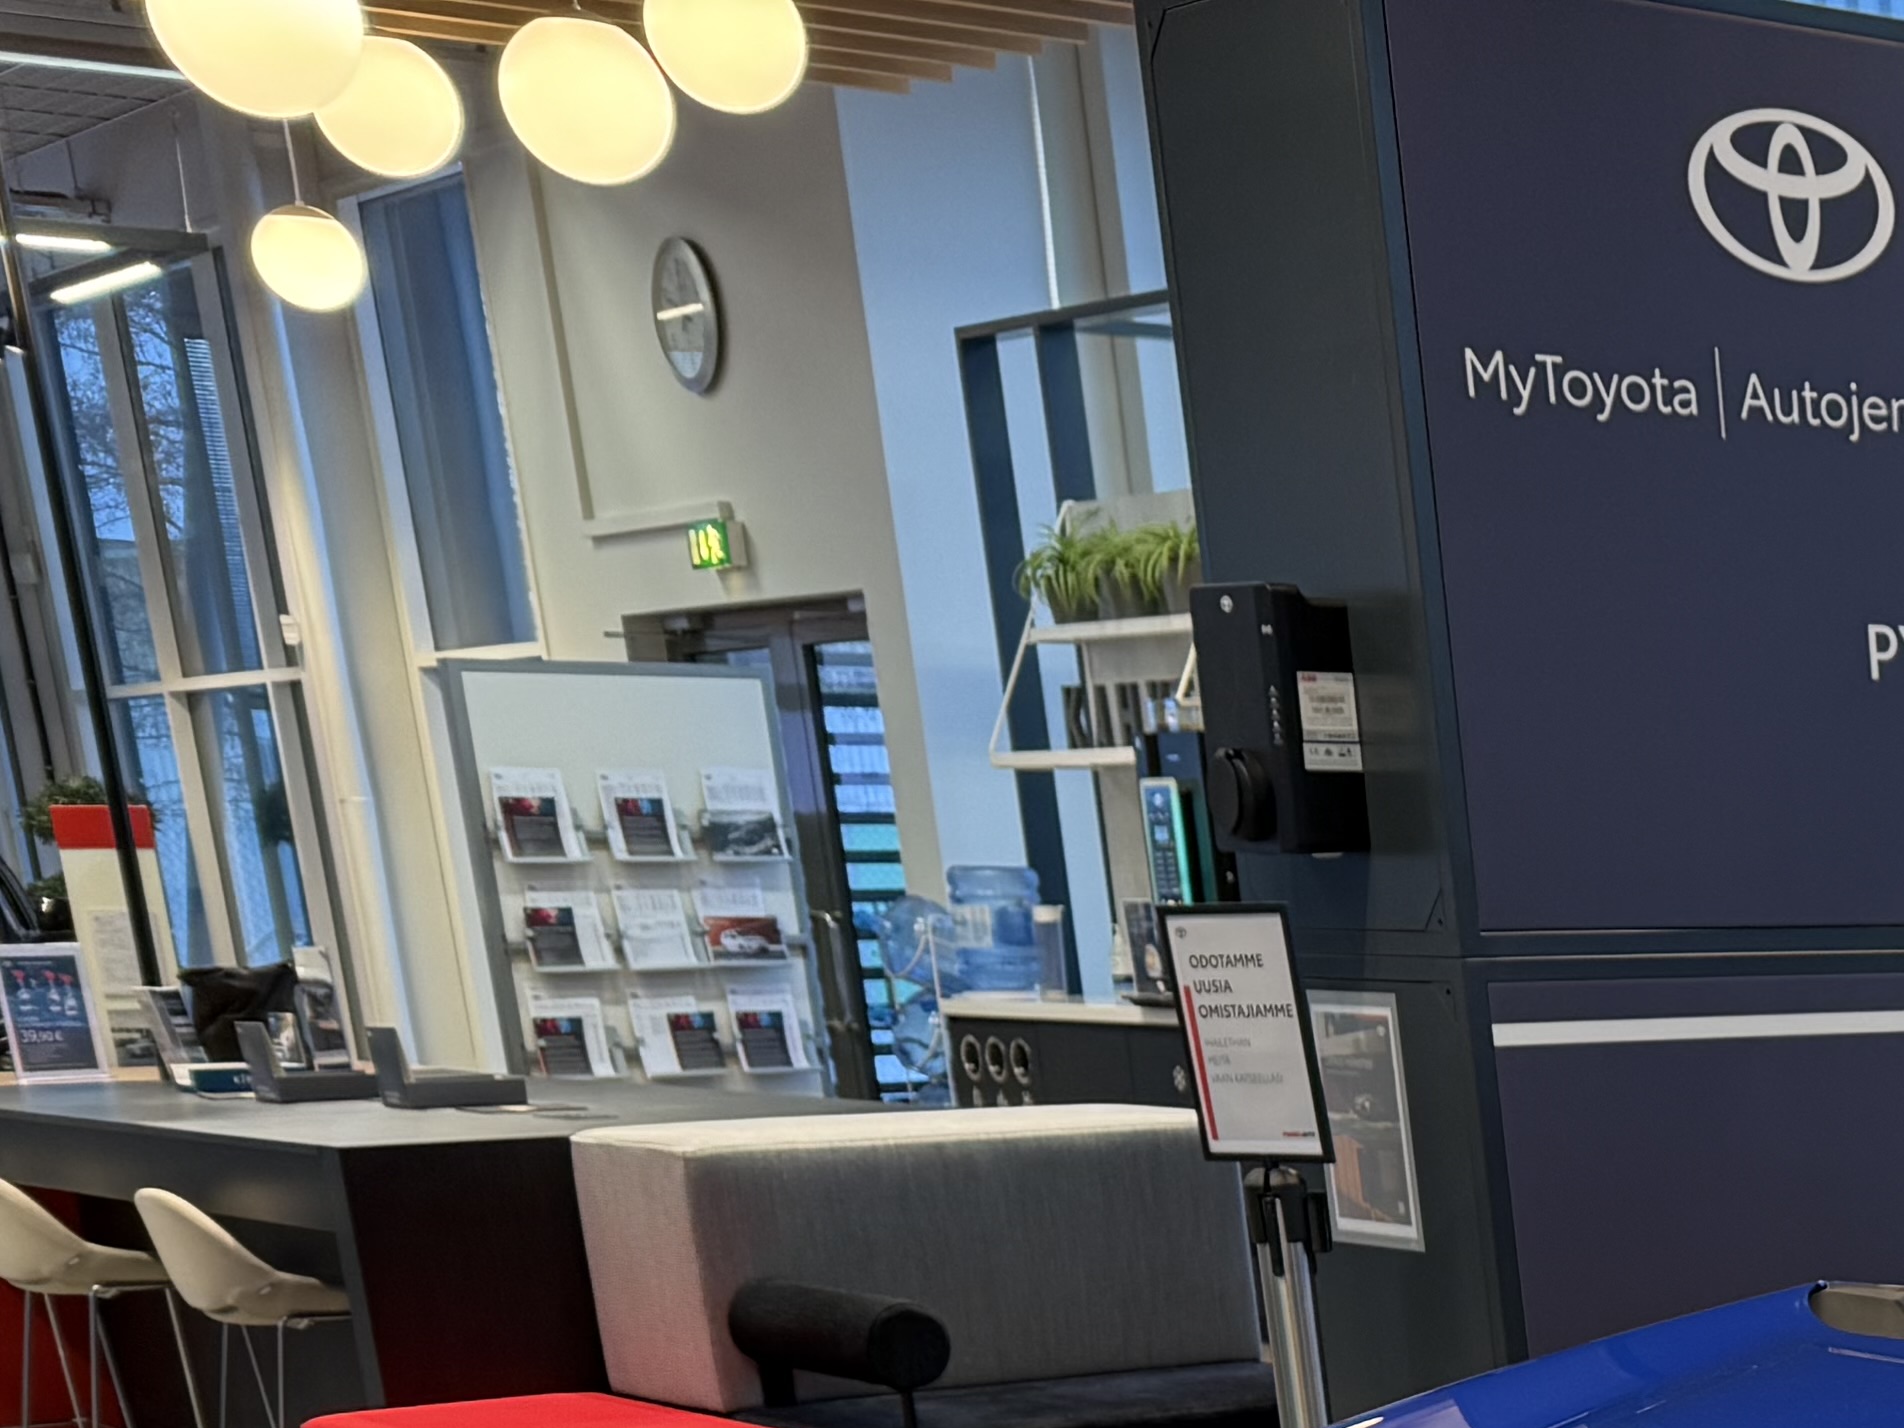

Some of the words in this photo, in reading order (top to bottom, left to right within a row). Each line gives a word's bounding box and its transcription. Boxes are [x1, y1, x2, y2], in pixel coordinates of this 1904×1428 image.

[1463, 346, 1699, 423] MyToyota
[1188, 952, 1265, 969] ODOTAMME
[1192, 979, 1233, 995] UUSIA
[1197, 1003, 1295, 1019] OMISTAJIAMME
